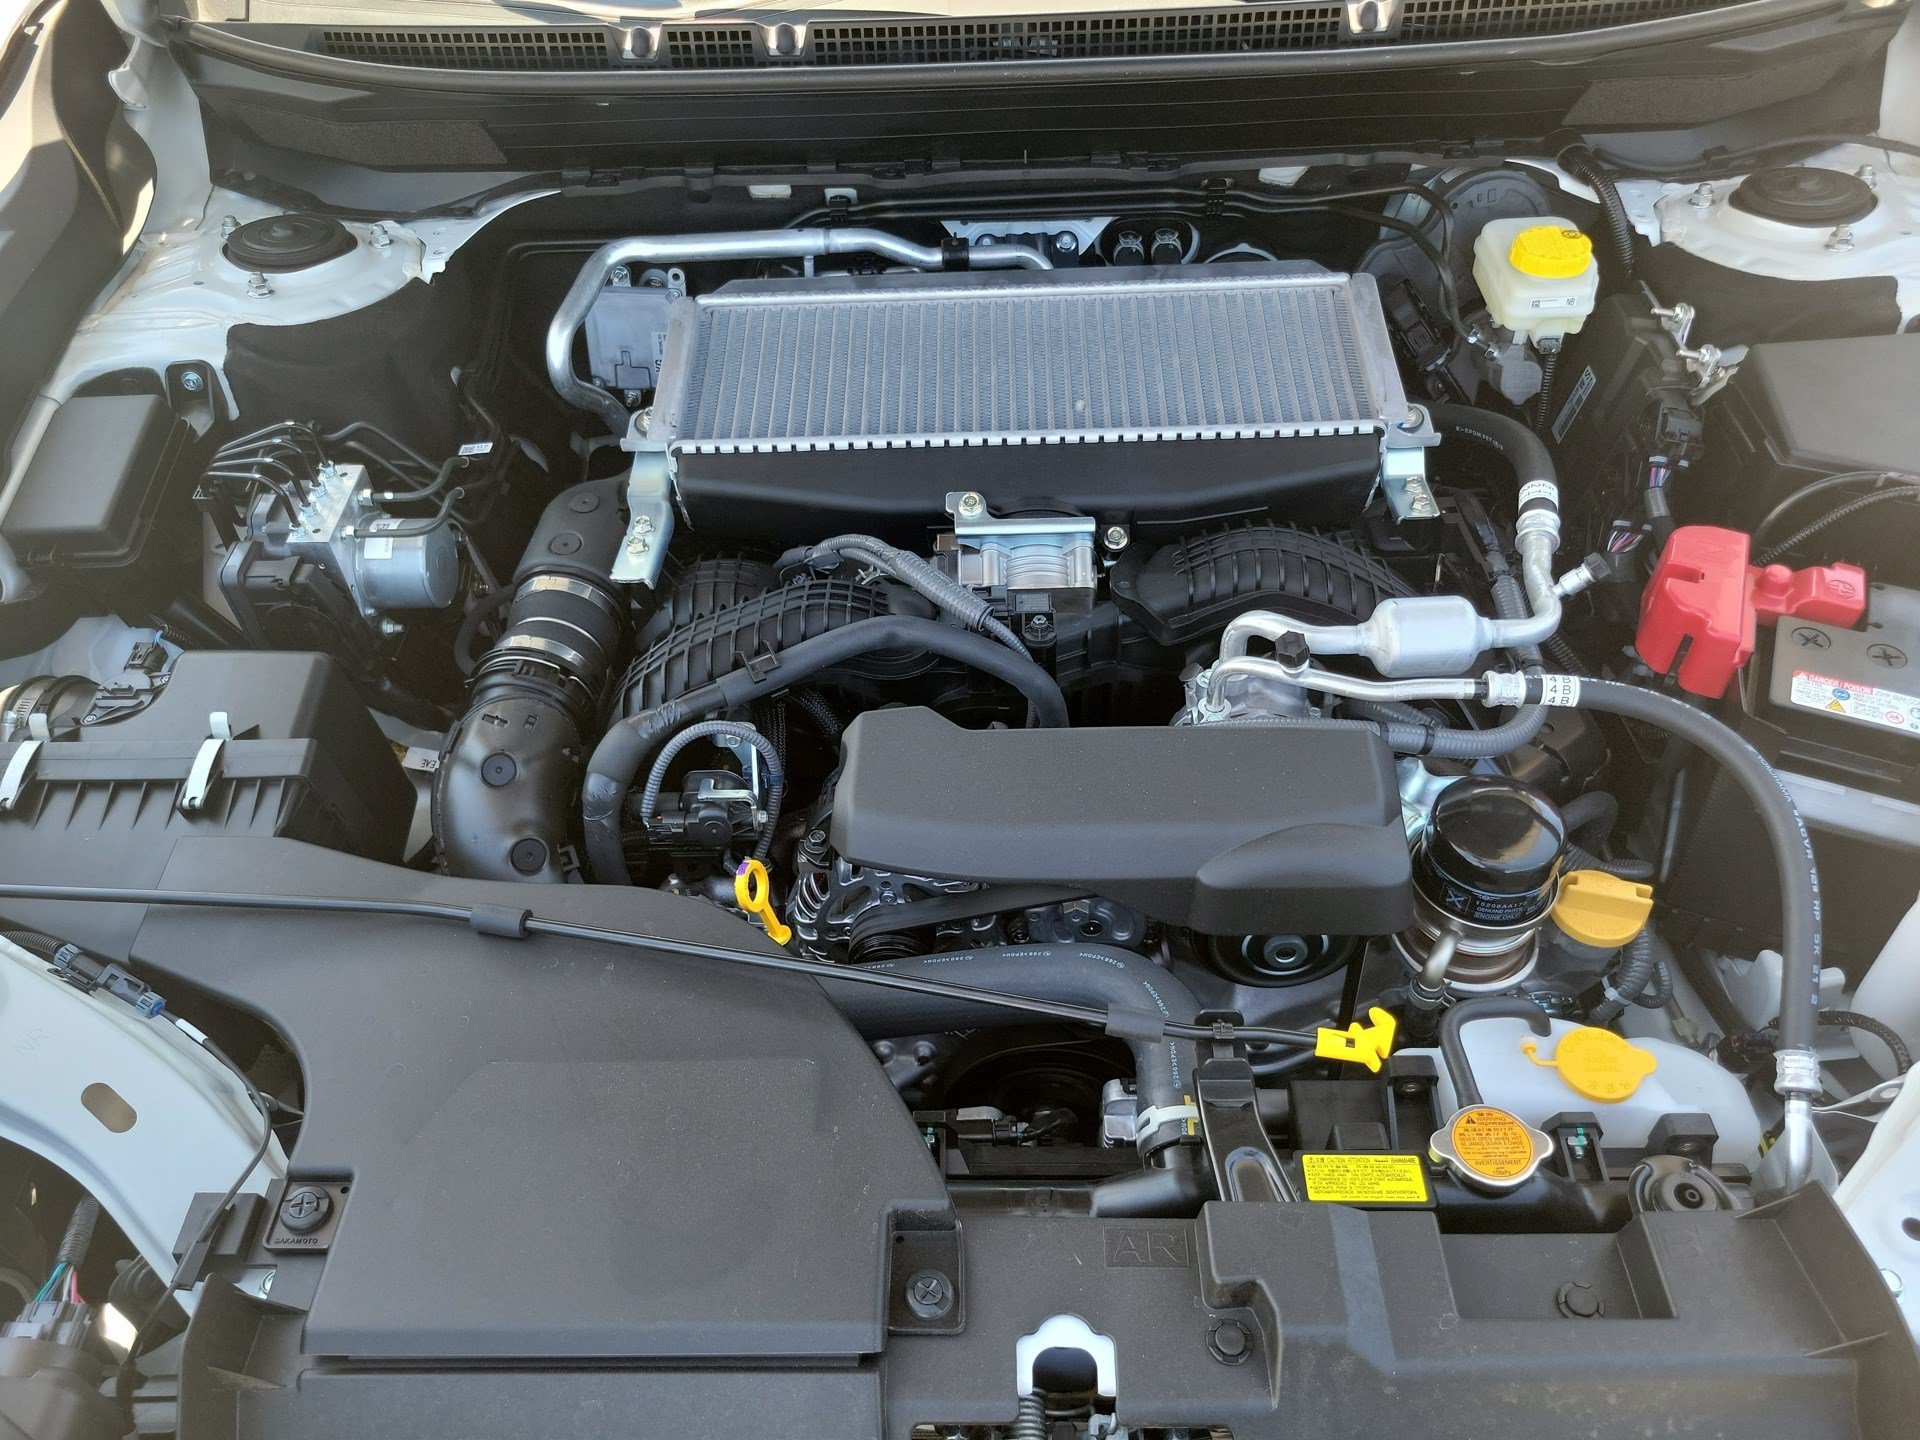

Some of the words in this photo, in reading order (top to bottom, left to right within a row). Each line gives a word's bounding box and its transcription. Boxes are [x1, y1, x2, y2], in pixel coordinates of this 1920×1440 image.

[1808, 675, 1839, 688] DANGER
[1844, 682, 1872, 694] POISON
[1112, 1230, 1180, 1263] AR
